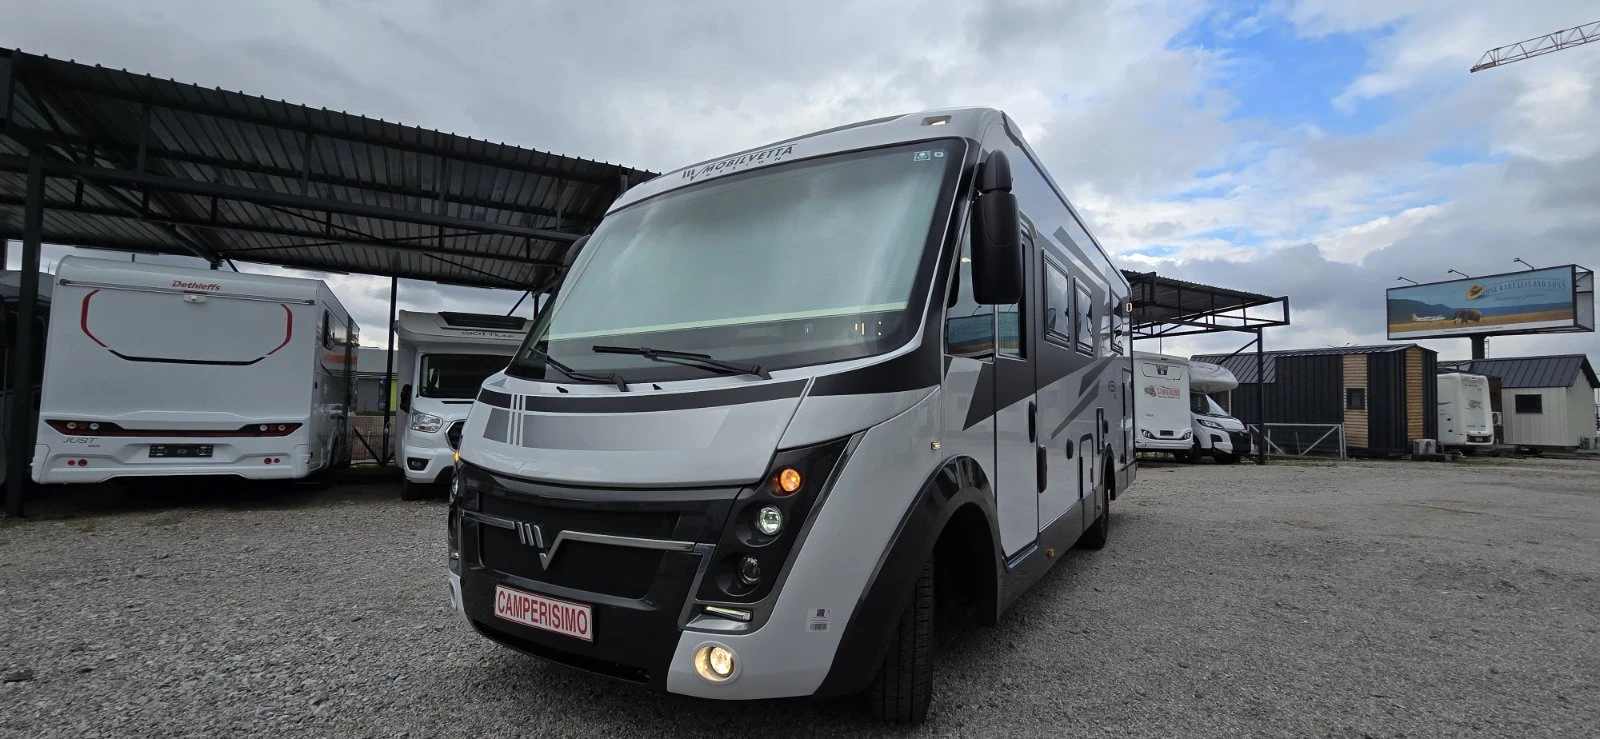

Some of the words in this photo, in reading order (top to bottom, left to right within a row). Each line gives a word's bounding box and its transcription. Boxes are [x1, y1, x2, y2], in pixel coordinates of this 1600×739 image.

[702, 146, 793, 174] MOBILVETTA
[172, 280, 221, 290] Dethleffs
[497, 590, 588, 634] CAMPERISIMO
